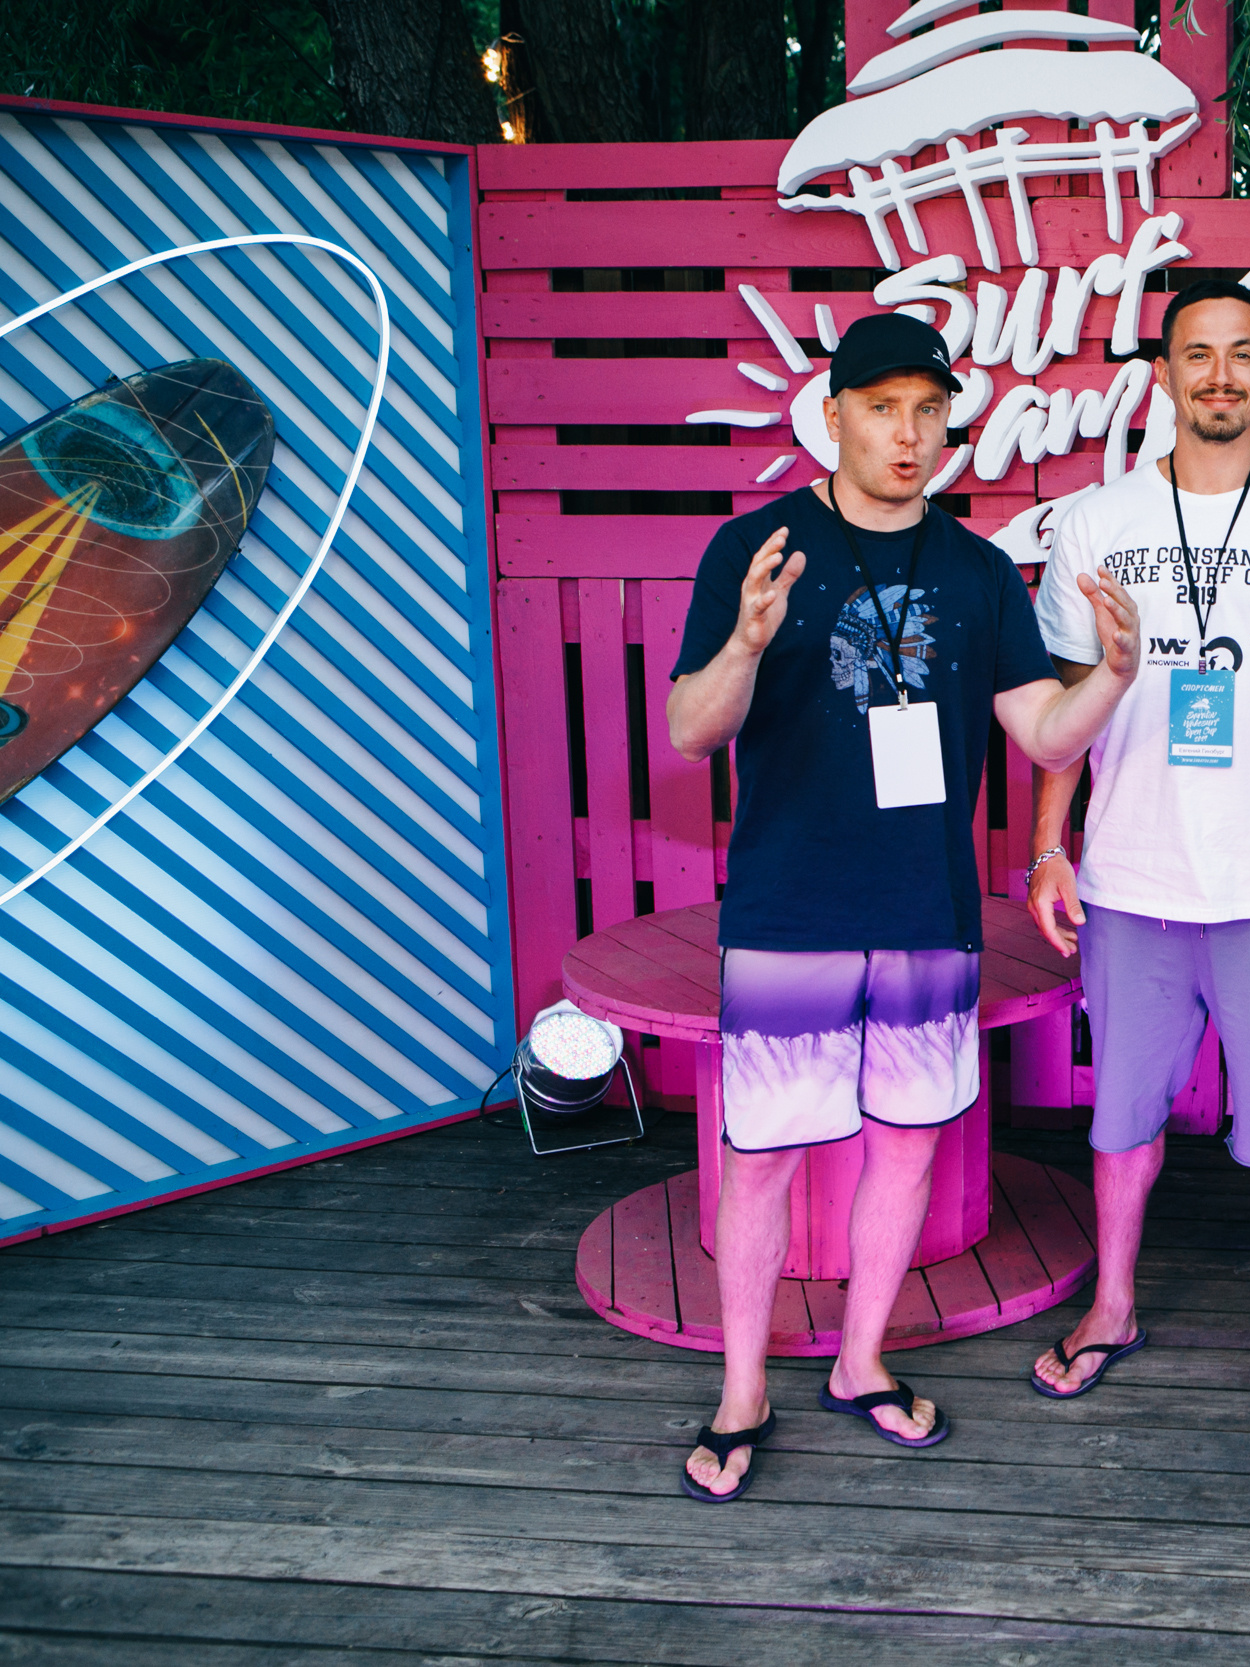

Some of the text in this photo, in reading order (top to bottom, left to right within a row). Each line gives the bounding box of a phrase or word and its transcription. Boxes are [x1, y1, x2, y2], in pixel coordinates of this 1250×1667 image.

[873, 211, 1193, 376] Surf
[1103, 547, 1150, 570] FORT
[1172, 565, 1234, 585] SURF
